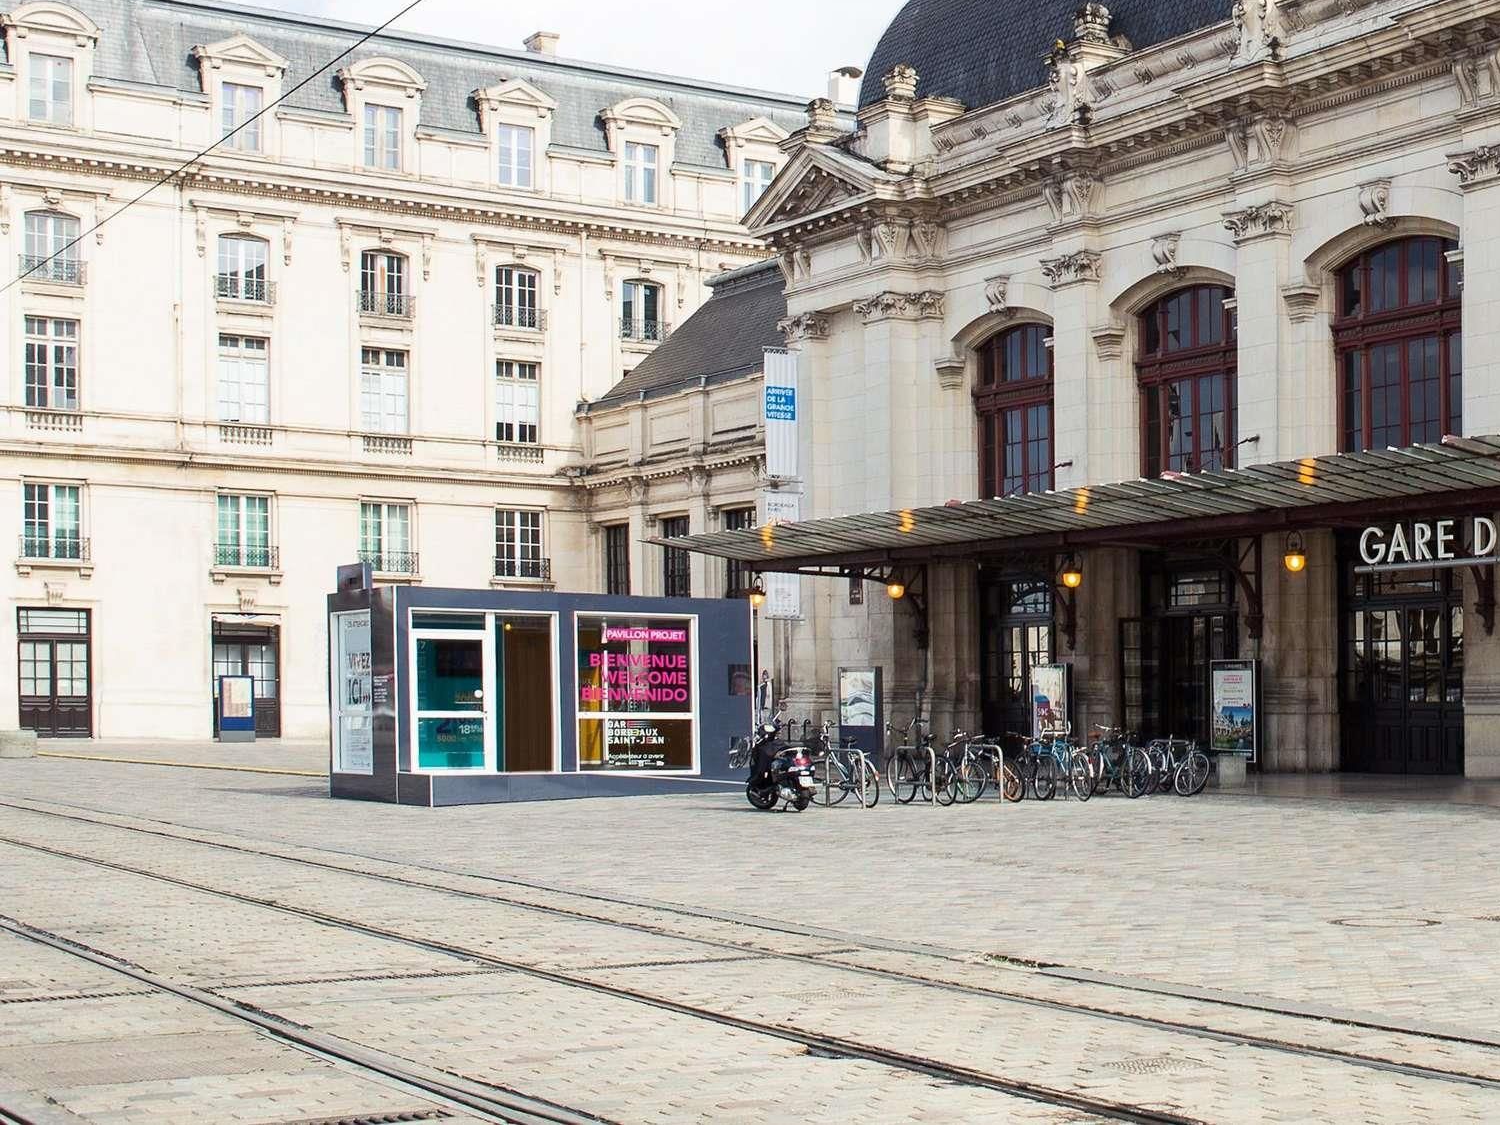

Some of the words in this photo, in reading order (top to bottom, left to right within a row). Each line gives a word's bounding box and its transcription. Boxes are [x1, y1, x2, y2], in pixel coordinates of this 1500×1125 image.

[1359, 519, 1455, 565] GARE
[607, 630, 649, 639] PAVILLON
[650, 630, 683, 640] PROJET
[589, 653, 687, 668] BIENVENUE
[602, 671, 687, 685] WELCOME
[581, 687, 688, 702] BIENVENIDO
[608, 728, 658, 737] BORDEAUX
[608, 736, 665, 745] SAINT-JEAN
